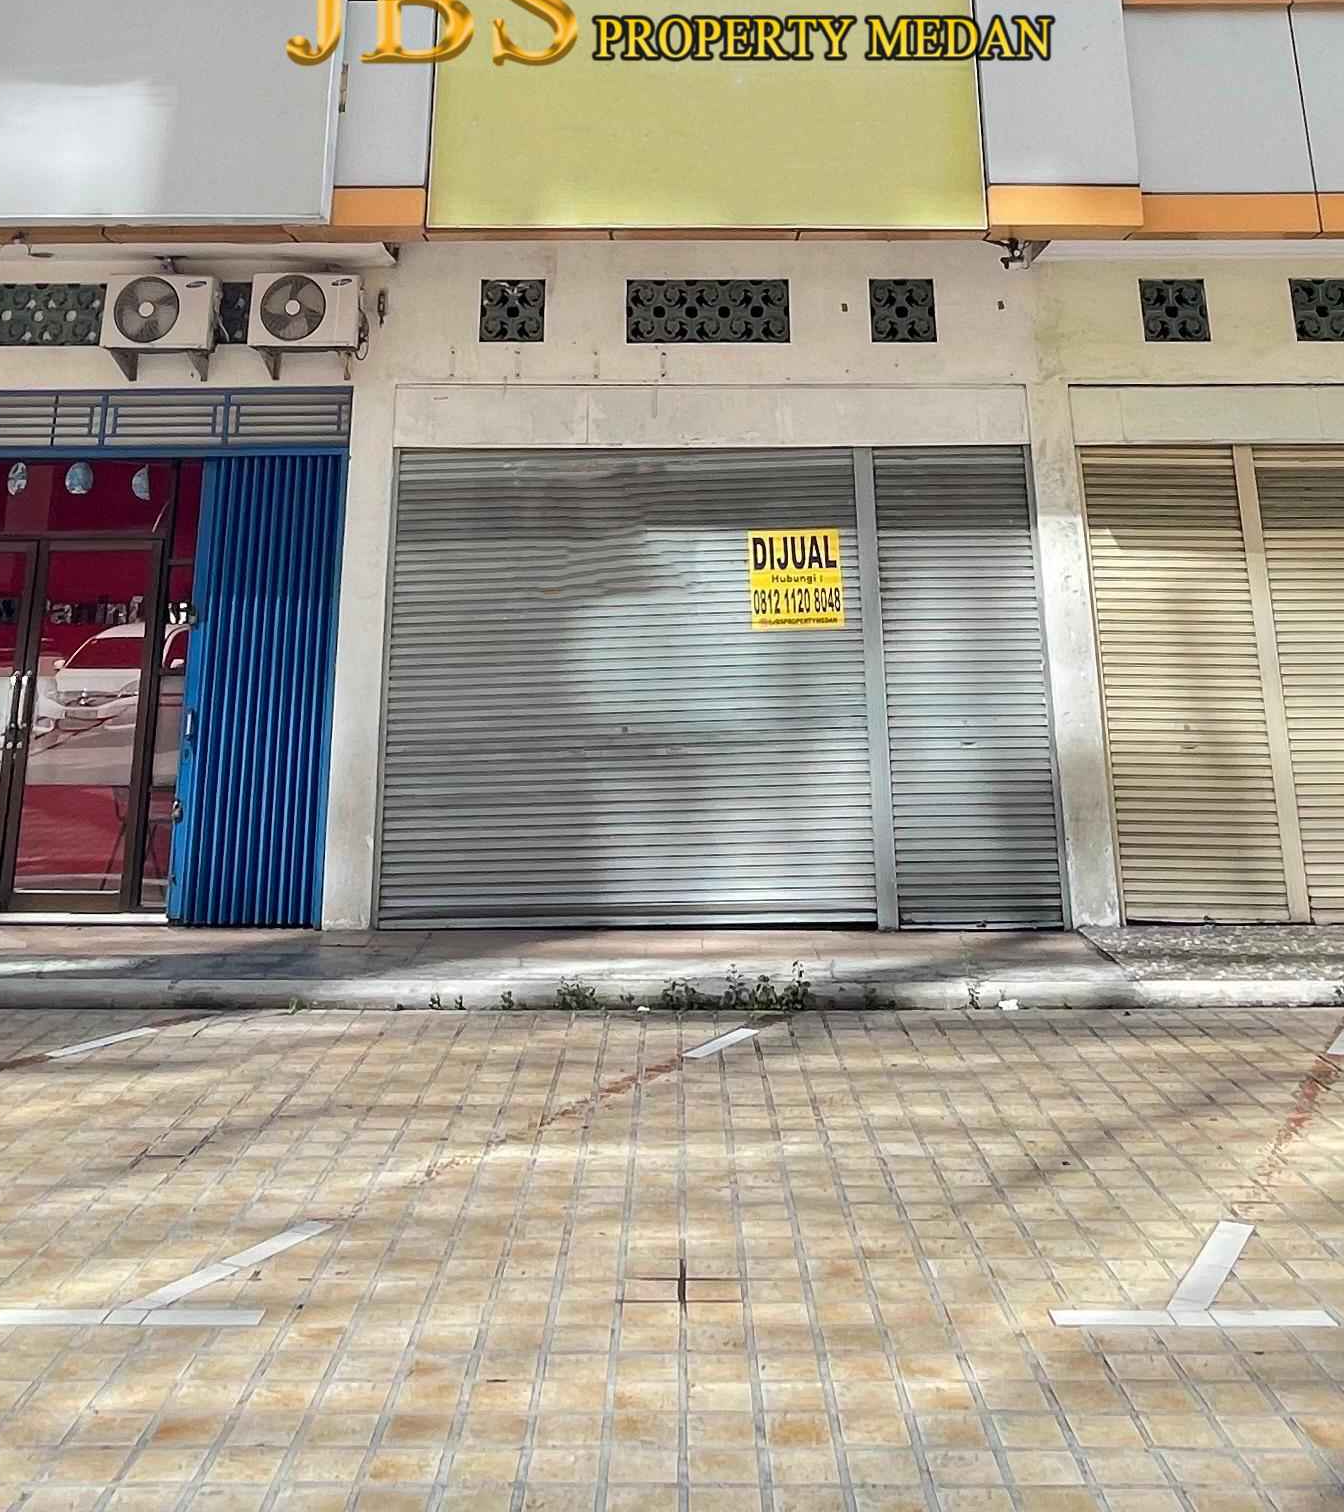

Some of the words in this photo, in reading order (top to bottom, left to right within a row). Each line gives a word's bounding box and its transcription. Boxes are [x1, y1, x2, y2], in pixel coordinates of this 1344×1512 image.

[752, 535, 837, 570] DIJUAL
[771, 573, 816, 584] Hubungi
[753, 589, 781, 614] 0812
[784, 588, 810, 614] 1120
[813, 587, 841, 613] 8048
